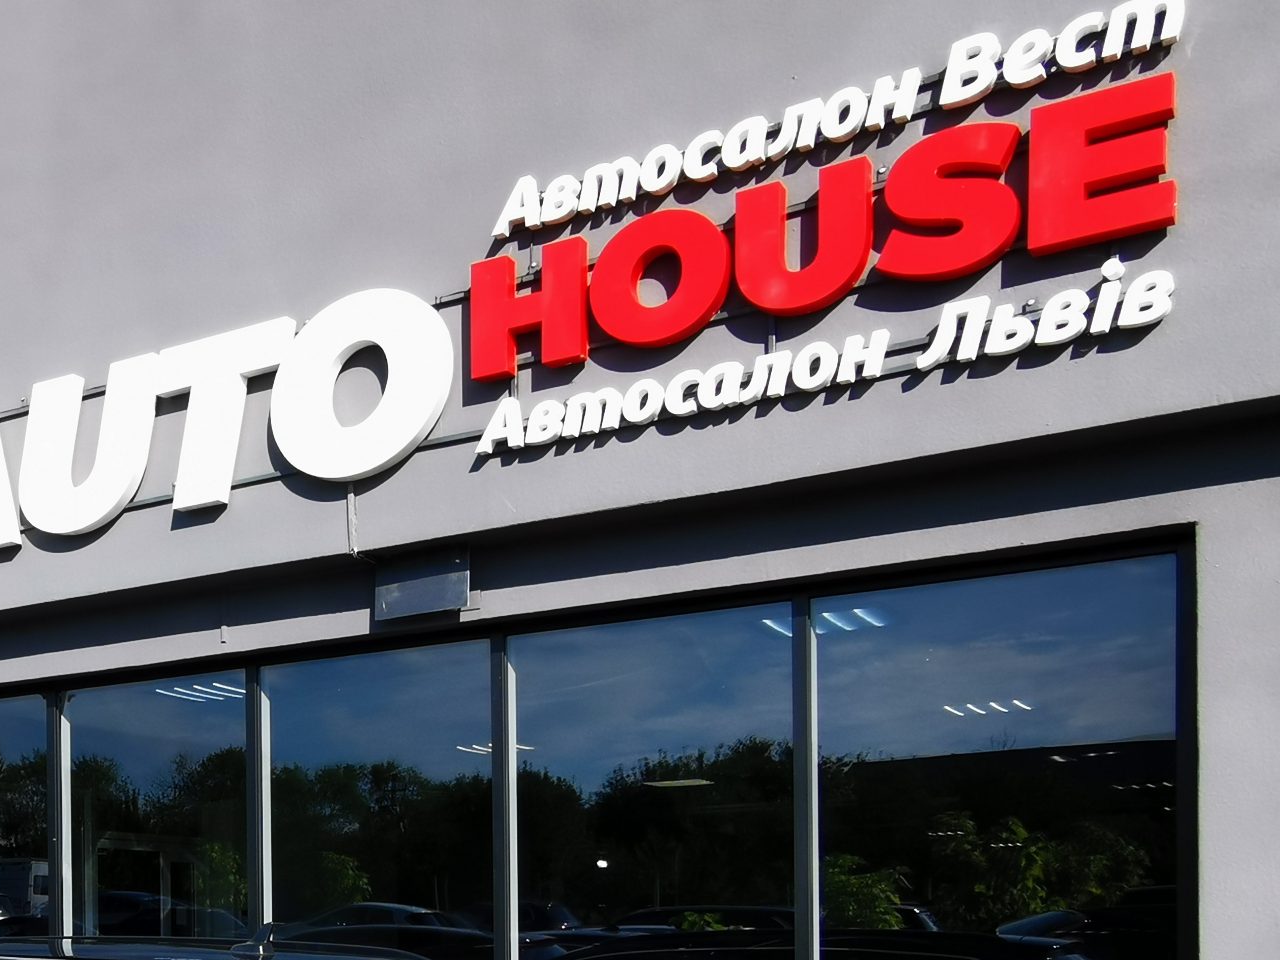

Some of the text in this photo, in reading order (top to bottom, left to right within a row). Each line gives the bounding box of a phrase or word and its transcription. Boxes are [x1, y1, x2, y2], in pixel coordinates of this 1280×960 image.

[470, 71, 1178, 382] HOUSE
[492, 0, 1186, 240] Автосалон Вест
[474, 259, 1176, 457] Автосалон Львів
